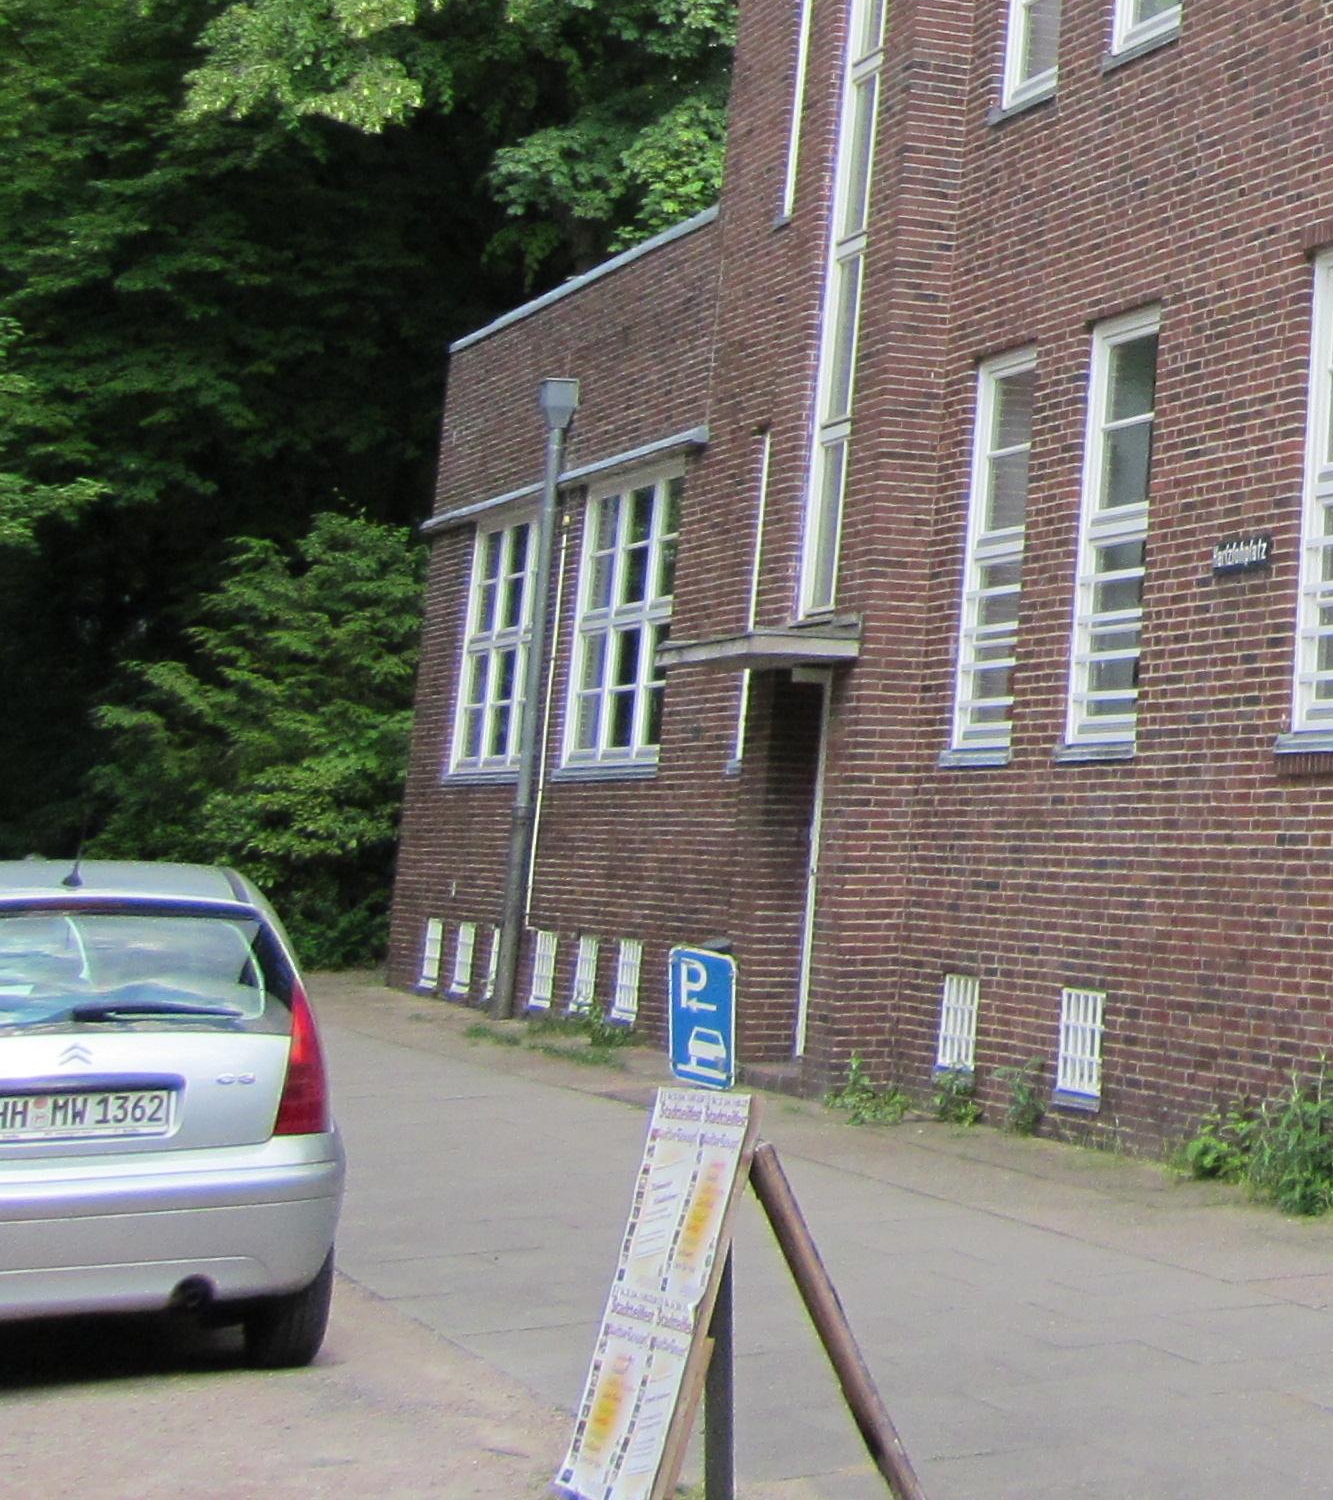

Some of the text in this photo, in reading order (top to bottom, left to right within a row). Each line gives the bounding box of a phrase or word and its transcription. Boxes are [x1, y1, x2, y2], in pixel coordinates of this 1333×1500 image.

[680, 957, 708, 1008] P
[50, 1097, 88, 1127] MW
[95, 1095, 165, 1125] 1362
